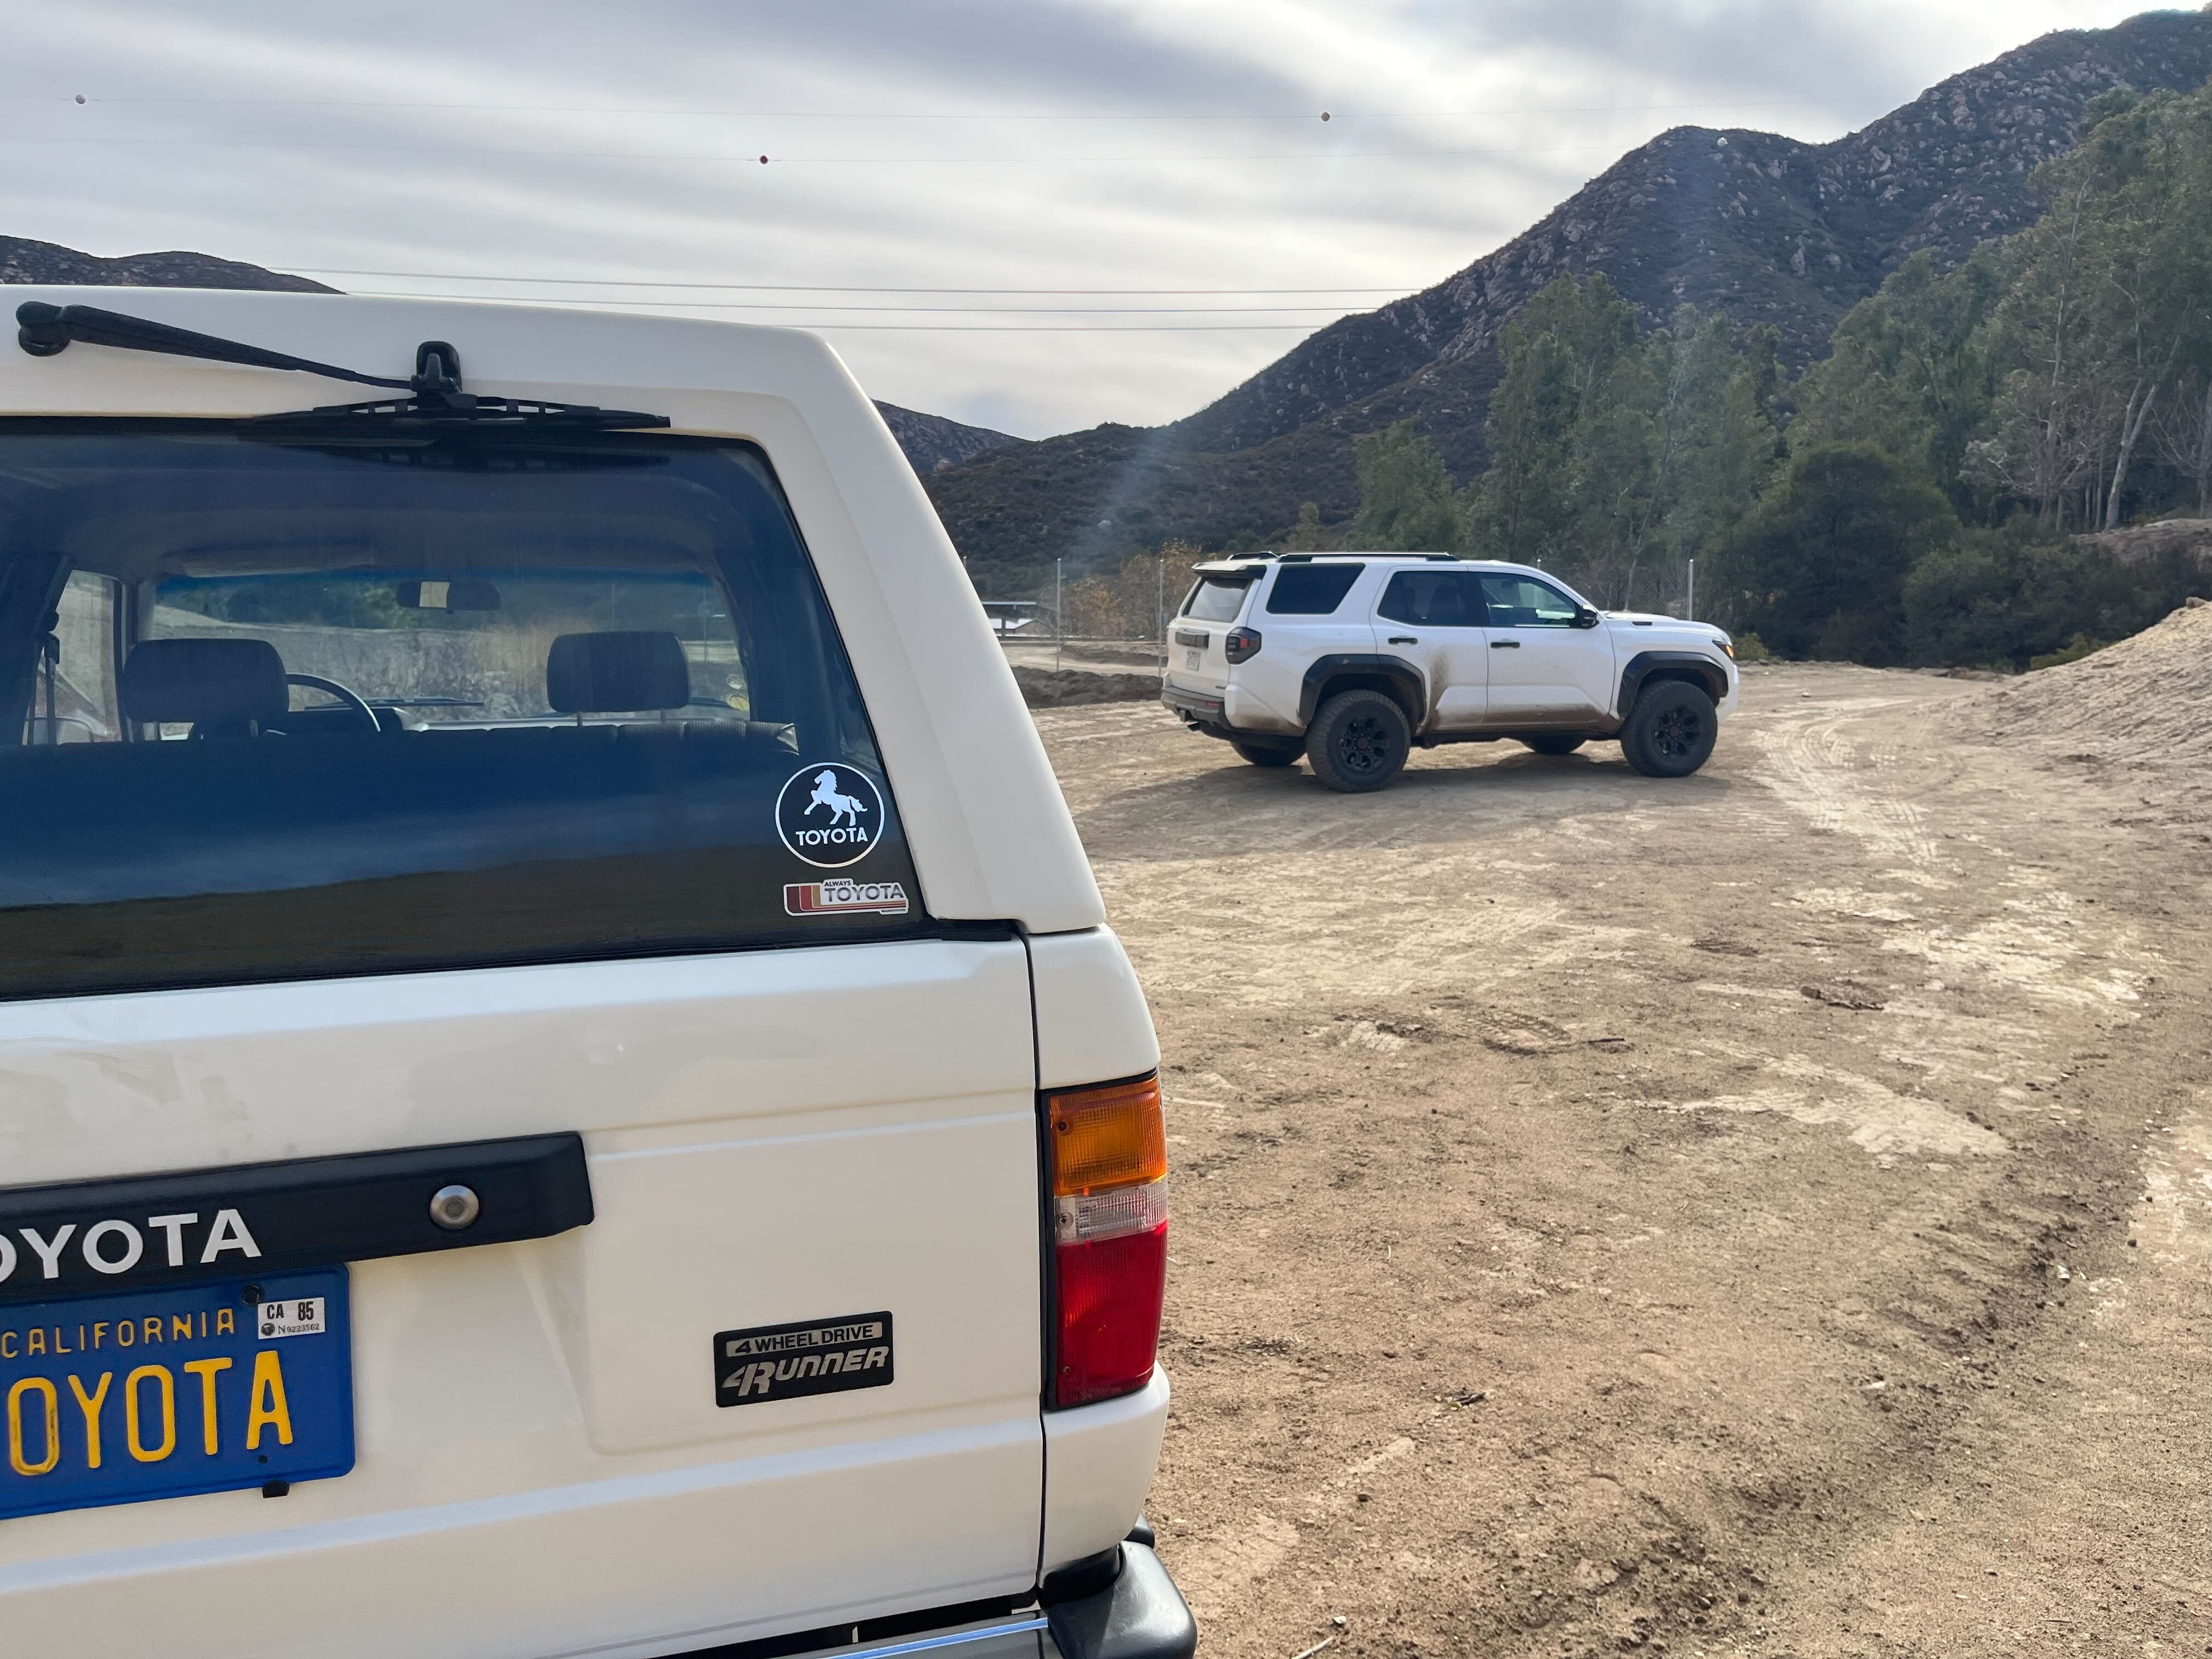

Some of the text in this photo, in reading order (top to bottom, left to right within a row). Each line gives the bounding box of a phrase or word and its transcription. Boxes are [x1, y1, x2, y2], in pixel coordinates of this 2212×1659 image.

[795, 827, 868, 845] TOYOTA
[825, 885, 904, 901] TOYOTA
[0, 1209, 262, 1282] YOTA
[267, 1301, 314, 1321] CA 85
[2, 1308, 234, 1358] CALIFORNIA
[735, 1325, 873, 1353] 4 WHEEL DRIVE
[721, 1346, 889, 1397] 4RUNNER
[8, 1351, 293, 1476] OYOTA
